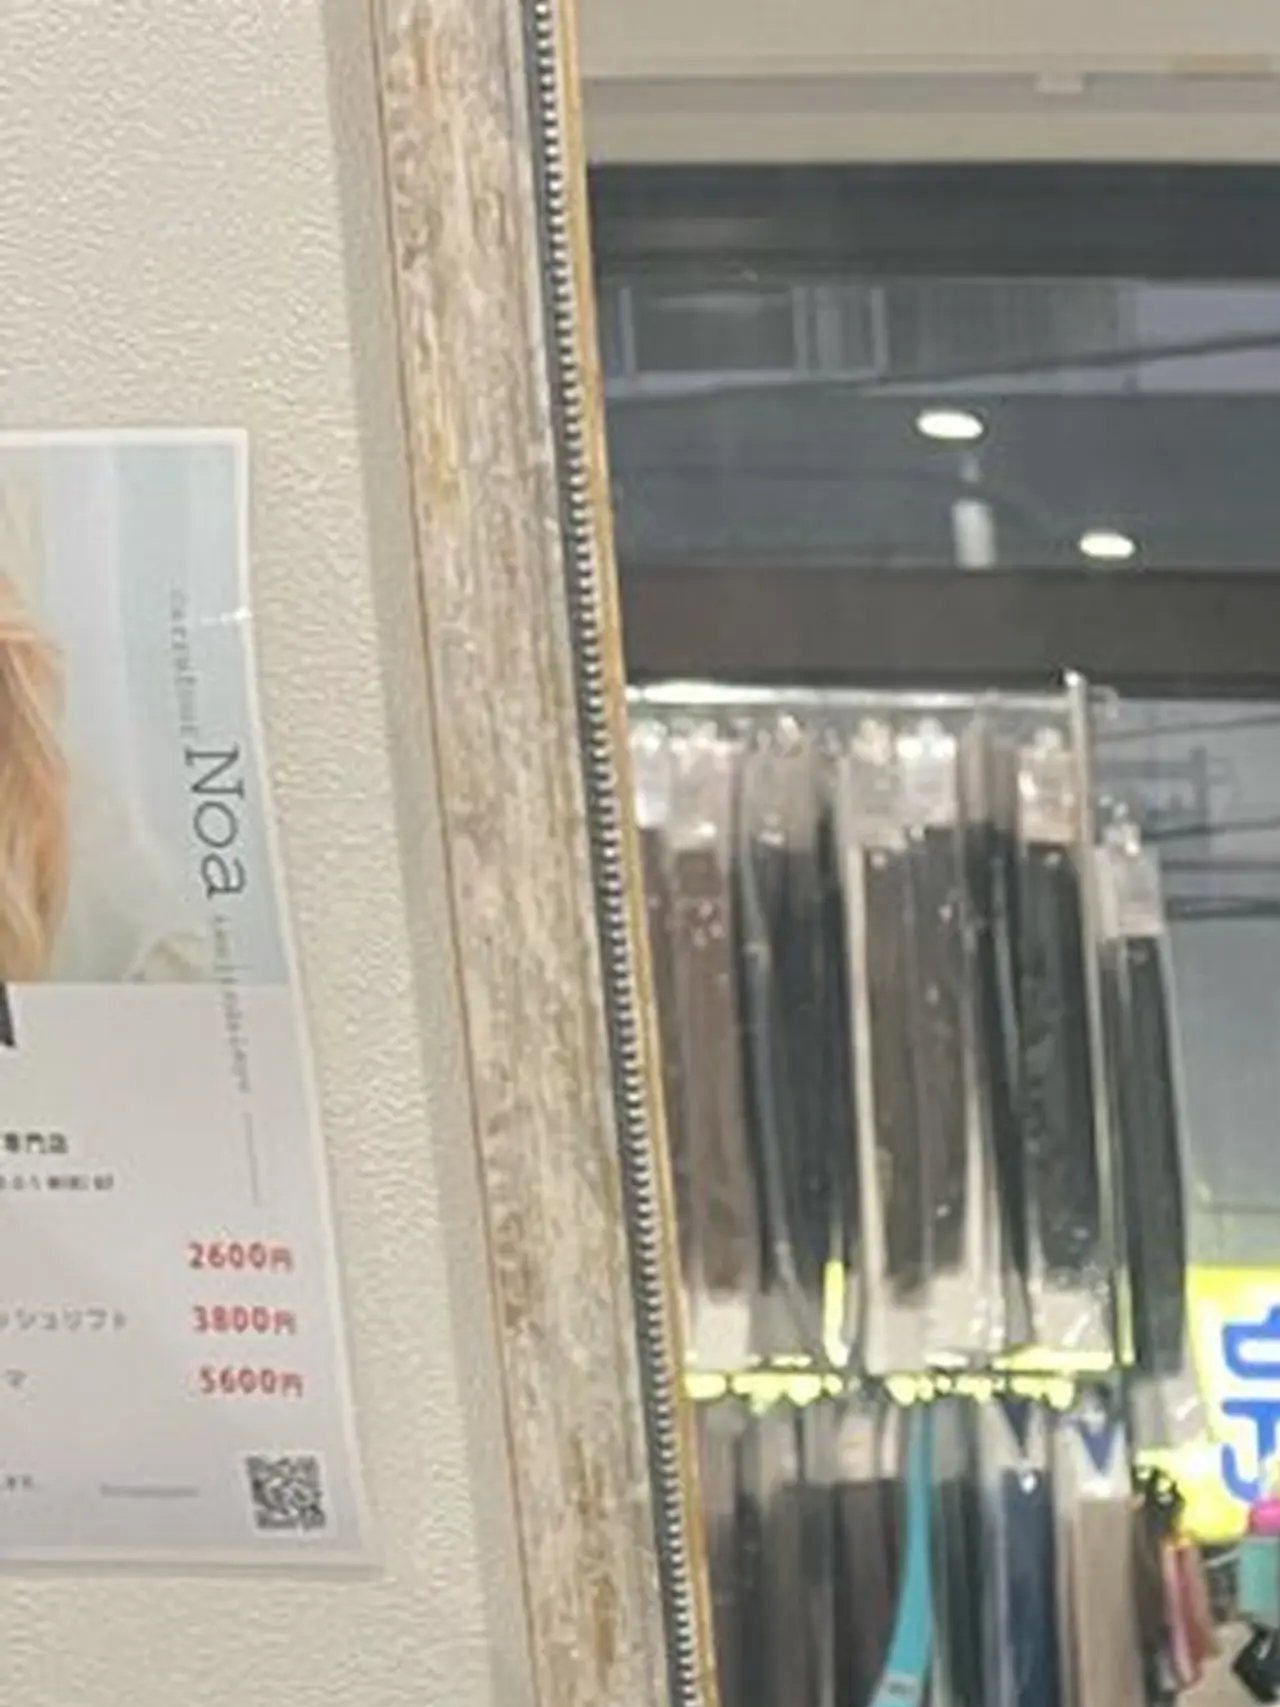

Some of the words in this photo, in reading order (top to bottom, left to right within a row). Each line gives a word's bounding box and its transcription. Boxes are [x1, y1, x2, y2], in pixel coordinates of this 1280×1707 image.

[184, 744, 247, 900] Noa
[188, 1241, 294, 1273] 2600円
[193, 1304, 296, 1336] 3800円
[200, 1364, 304, 1399] 5600円
